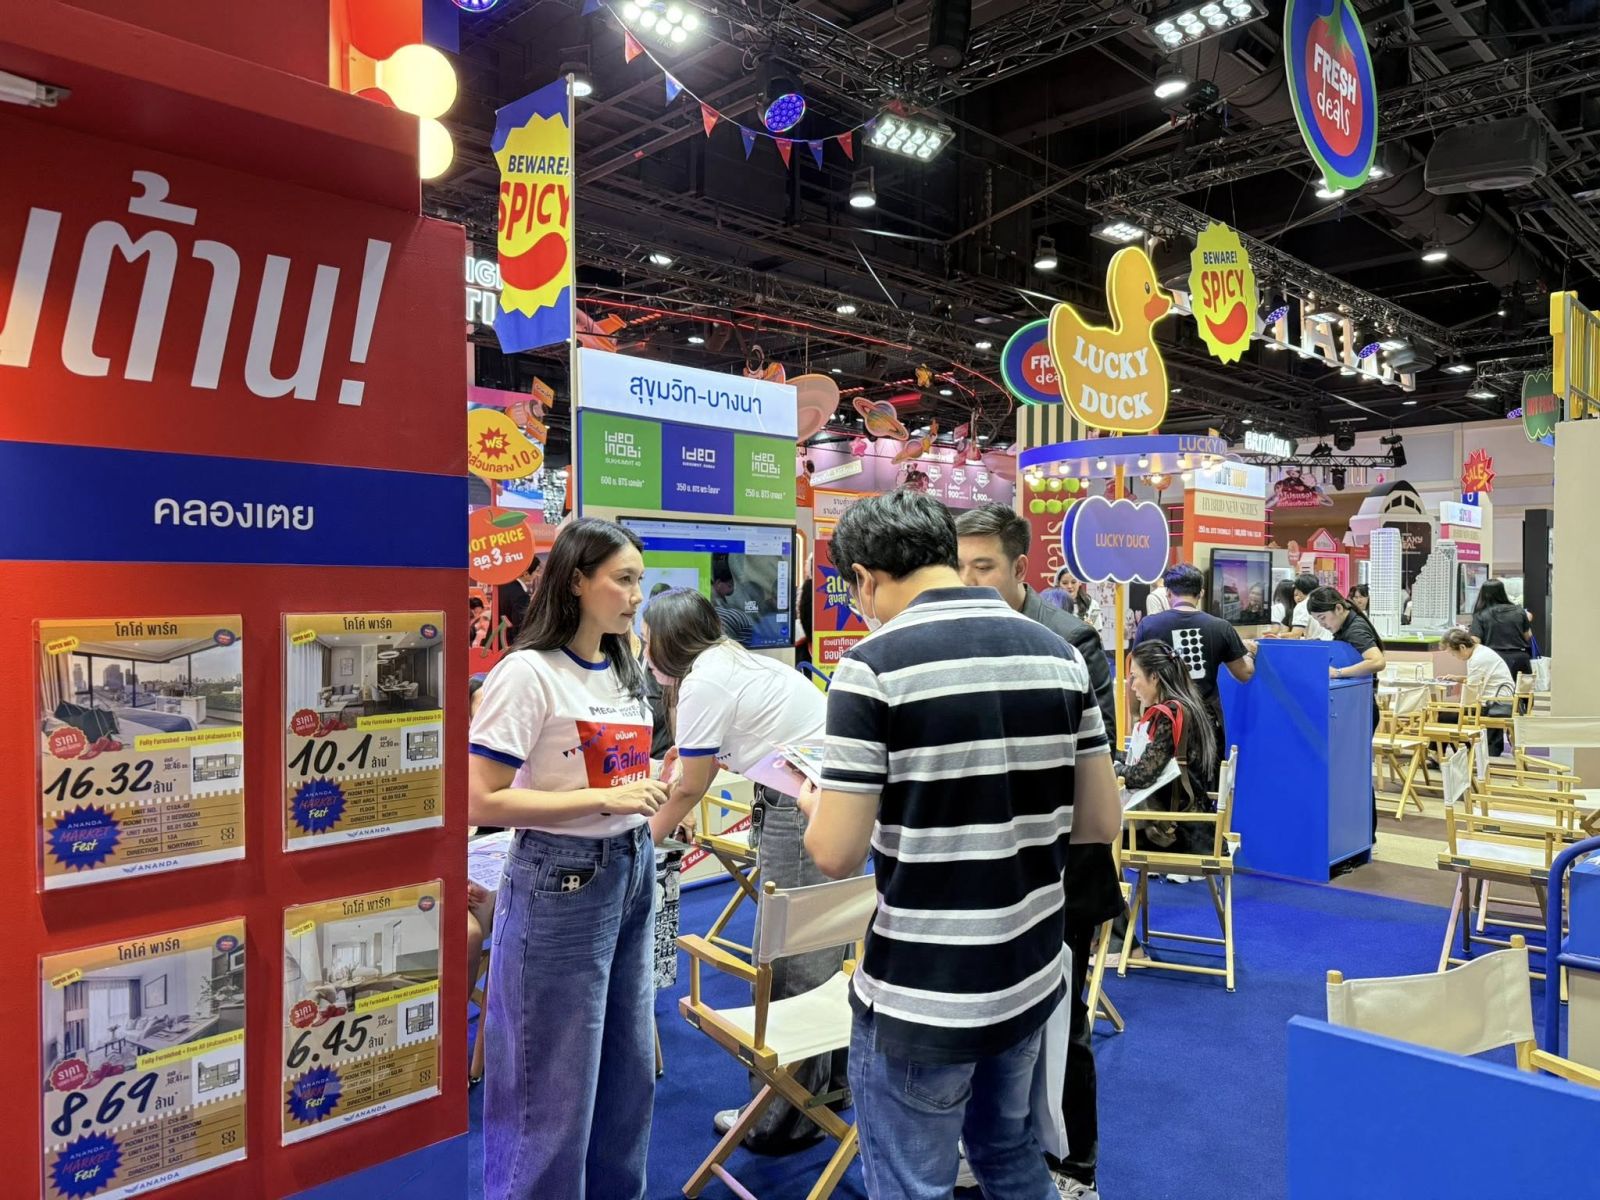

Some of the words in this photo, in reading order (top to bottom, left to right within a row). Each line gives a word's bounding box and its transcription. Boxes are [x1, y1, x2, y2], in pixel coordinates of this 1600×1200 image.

[1313, 43, 1357, 105] FRESH
[1317, 79, 1350, 136] deals
[498, 181, 570, 240] SPICY
[1202, 251, 1237, 264] BEWARE!
[1201, 269, 1244, 313] SPICY
[1031, 355, 1054, 370] FR
[1072, 336, 1149, 380] LUCKY
[630, 376, 762, 415] สุขุมวิท-บางนา
[1079, 384, 1152, 420] DUCK
[1178, 436, 1218, 454] LUCKY
[512, 450, 530, 468] 10
[154, 498, 314, 530] คลองเตย
[469, 536, 487, 552] OT
[489, 528, 526, 547] PRICE
[1095, 534, 1125, 548] LUCKY
[1126, 534, 1150, 549] DUCK
[491, 548, 503, 566] 3
[505, 552, 524, 563] ล้าน
[1040, 521, 1064, 587] deals
[589, 706, 617, 716] MEGA
[288, 733, 373, 776] 10.1
[44, 759, 154, 801] 16.32
[308, 808, 329, 819] Fest
[358, 827, 390, 837] ANANDA
[72, 839, 98, 853] Fest
[138, 859, 179, 871] ANANDA
[688, 849, 705, 864] SALE
[286, 1014, 373, 1069] 6.45
[51, 1072, 160, 1136] 8.69
[305, 1096, 325, 1109] Fest
[355, 1104, 386, 1119] ANANDA
[168, 1154, 183, 1163] EAST
[74, 1166, 100, 1182] Fest
[139, 1172, 180, 1191] ANANDA
